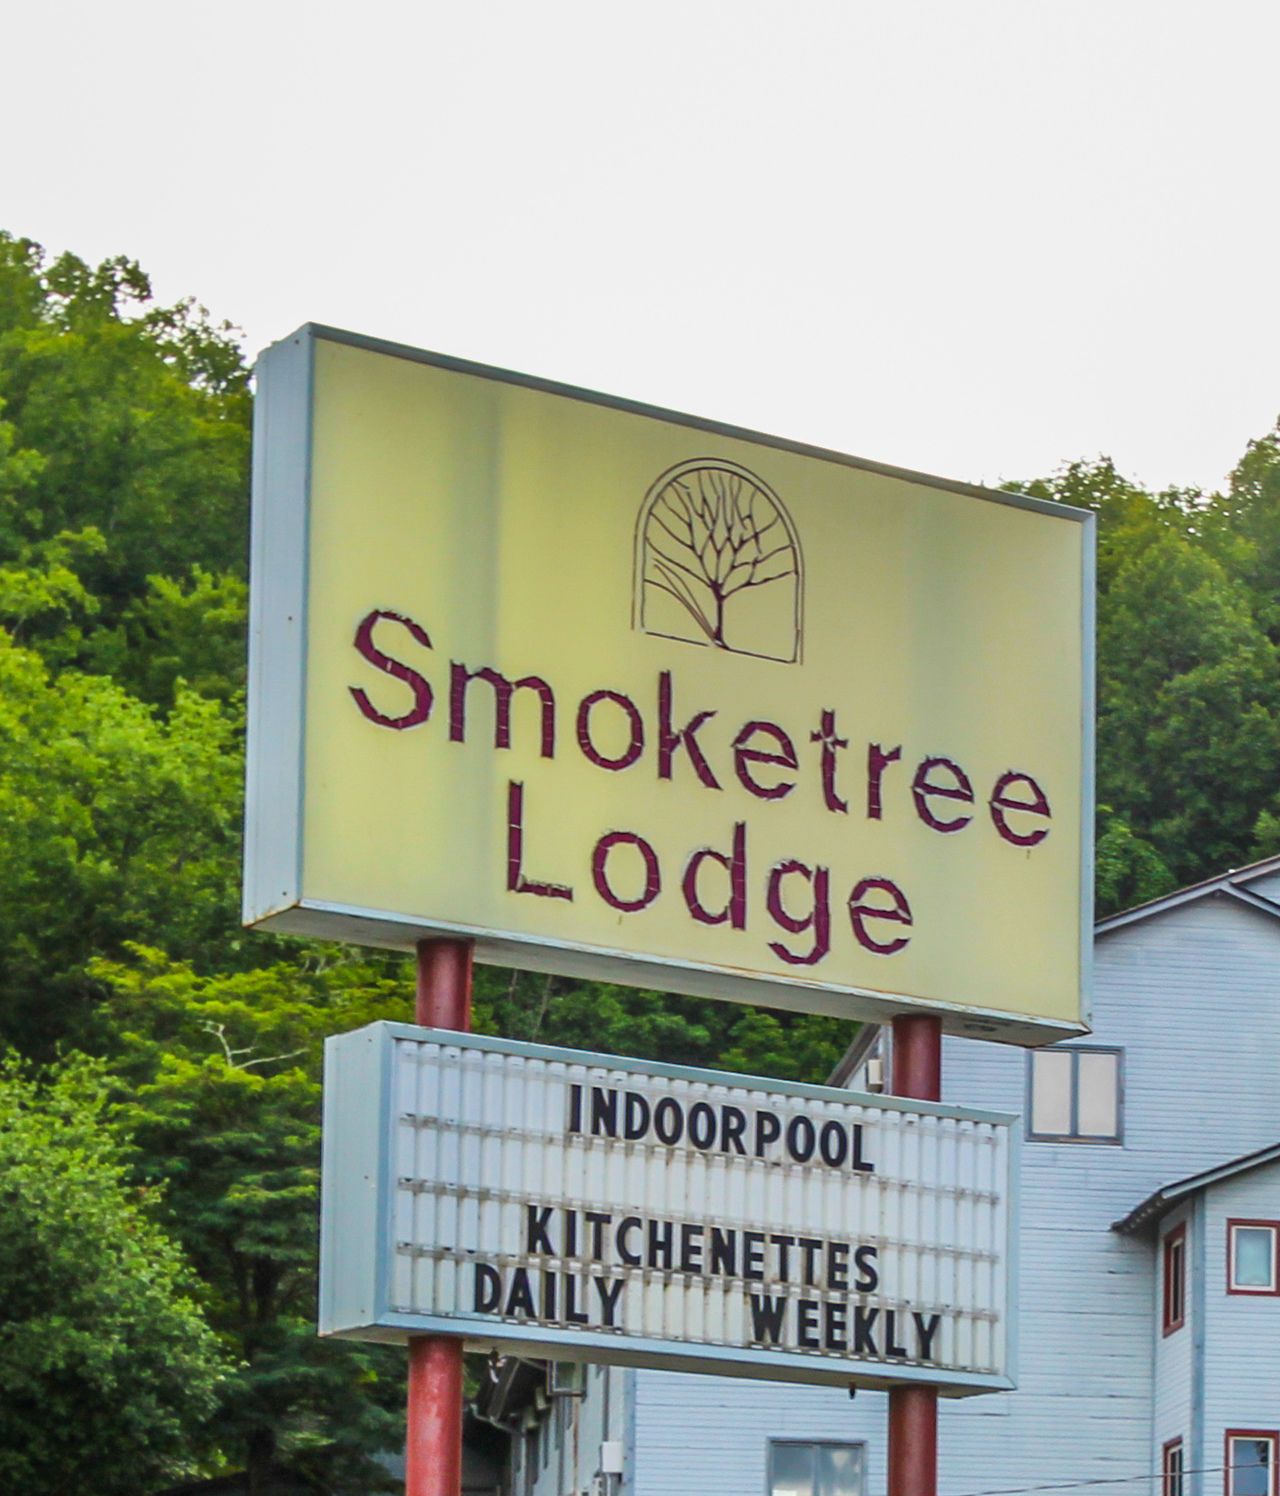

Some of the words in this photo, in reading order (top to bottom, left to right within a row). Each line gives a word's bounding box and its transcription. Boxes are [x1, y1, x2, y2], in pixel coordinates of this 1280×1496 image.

[346, 606, 1053, 848] Smoketree
[506, 778, 914, 968] Lodge
[474, 1262, 625, 1327] DAILY
[750, 1293, 942, 1361] WEEKLY
[527, 1204, 879, 1293] KITCHENETTES
